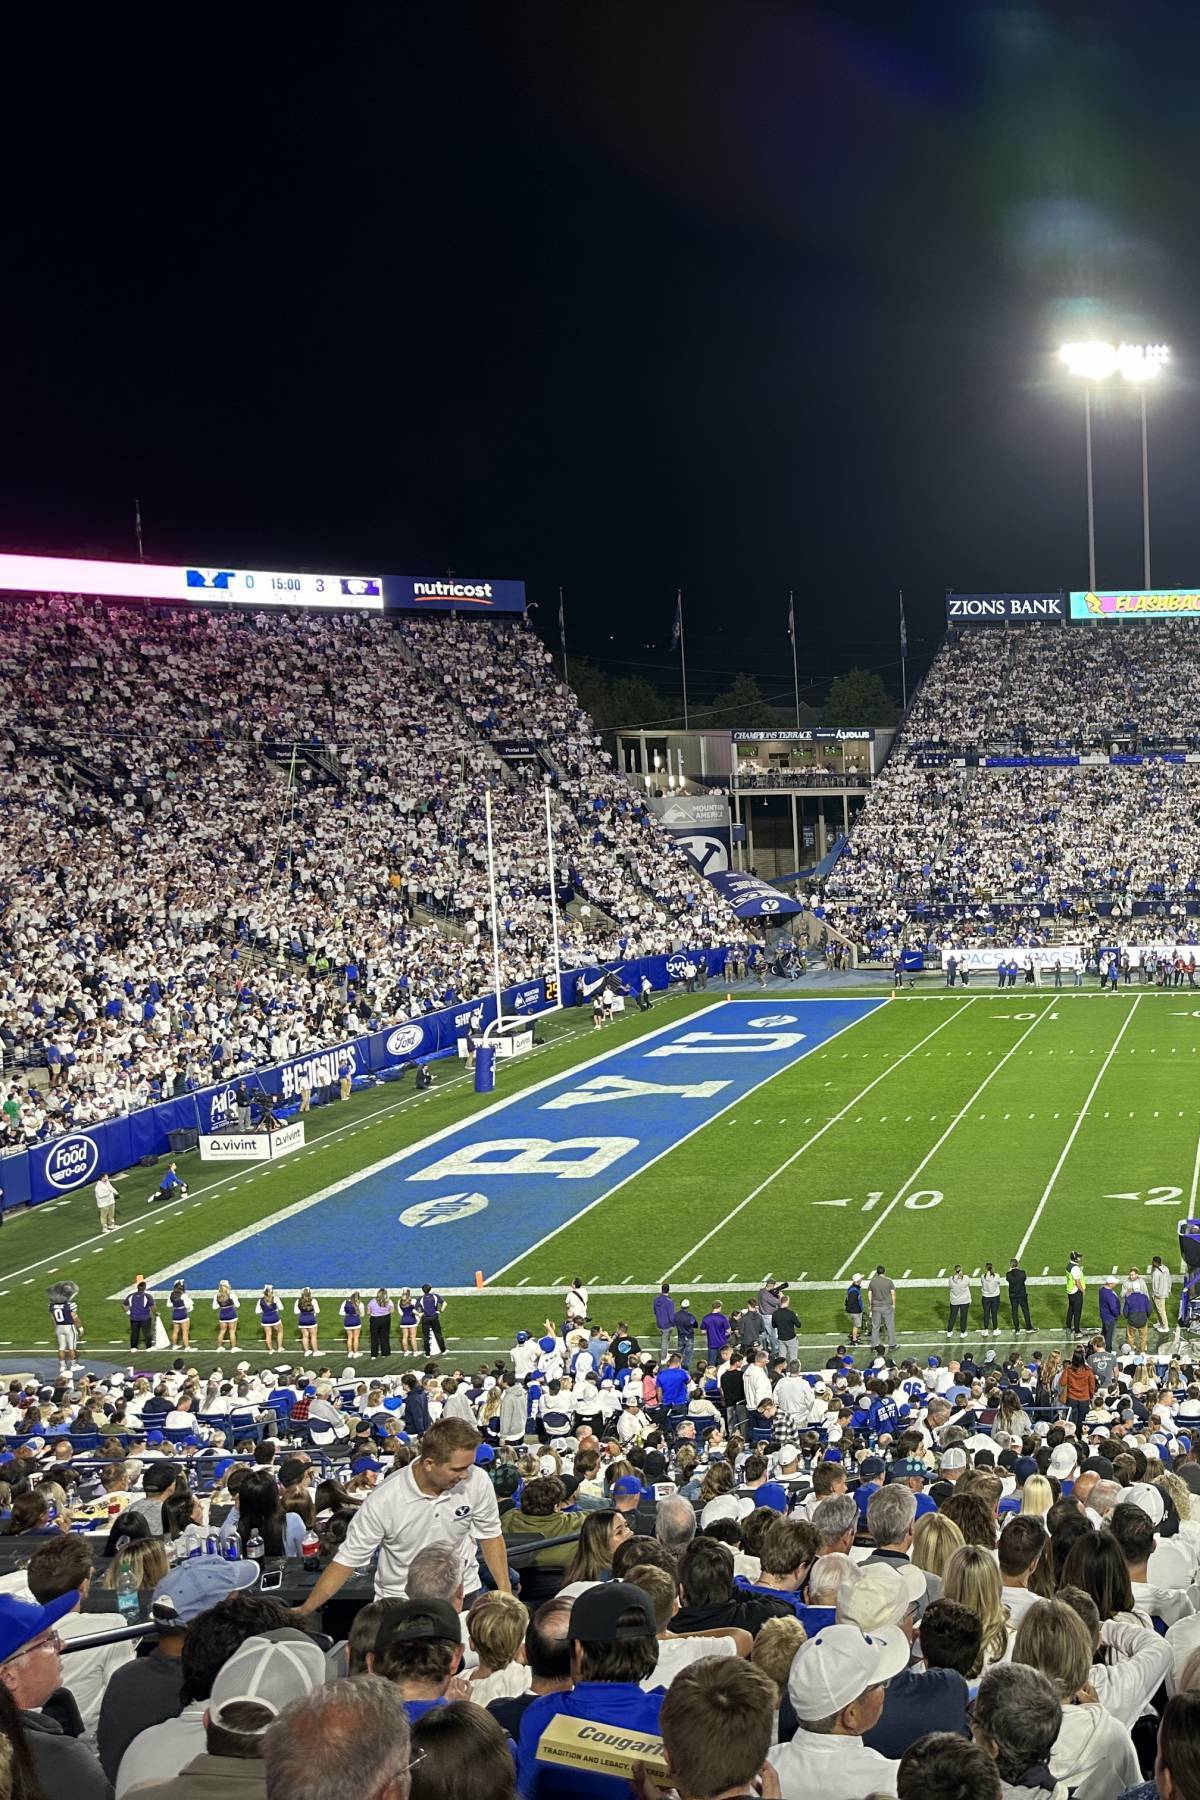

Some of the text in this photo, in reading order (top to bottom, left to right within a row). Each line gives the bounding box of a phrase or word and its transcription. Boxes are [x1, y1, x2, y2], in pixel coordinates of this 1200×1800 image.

[245, 575, 255, 590] 0
[271, 577, 302, 591] 15:00
[315, 578, 325, 593] 3
[413, 580, 493, 599] nutricost
[949, 599, 1062, 615] ZIONS BANK
[733, 730, 812, 740] CHAMPIONS TERRACE
[394, 1030, 418, 1050] Ford
[281, 1128, 301, 1143] vivint
[223, 1139, 257, 1151] vivint
[56, 1141, 88, 1169] Food
[53, 1162, 88, 1181] TO-GO
[54, 1308, 65, 1323] 0
[903, 1381, 922, 1396] 96
[543, 1746, 630, 1771] TRADITION AND LEGACY,
